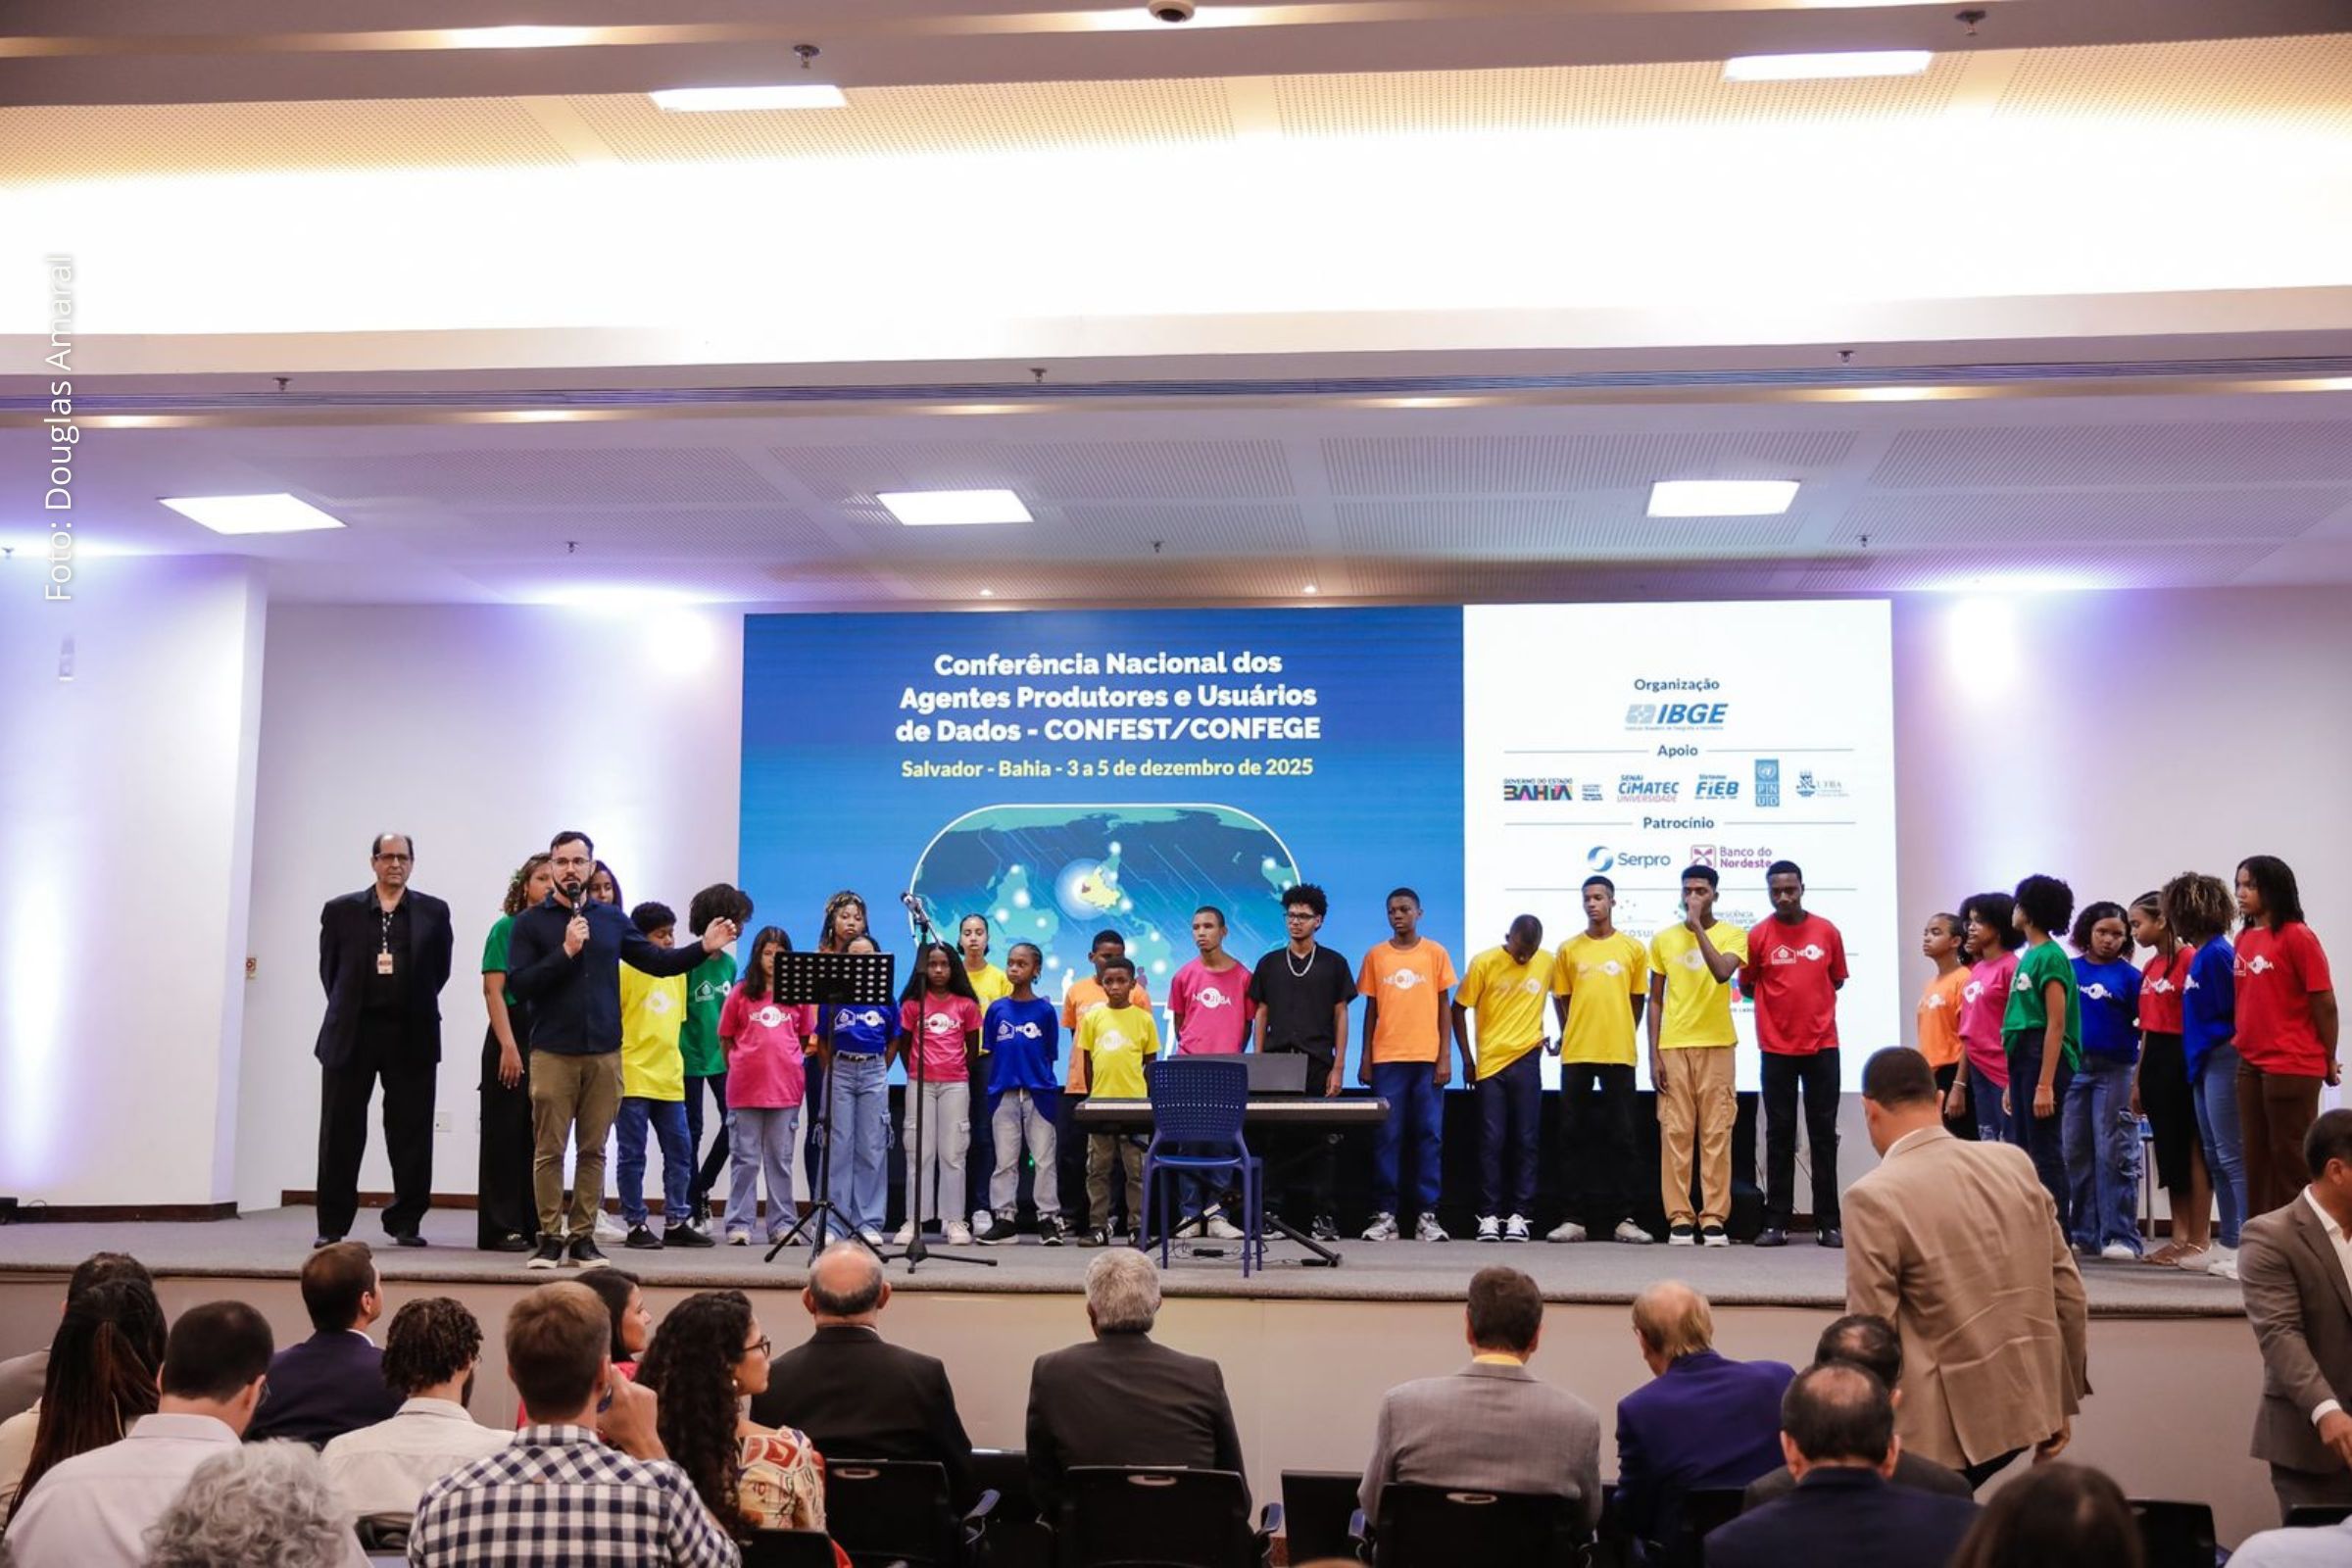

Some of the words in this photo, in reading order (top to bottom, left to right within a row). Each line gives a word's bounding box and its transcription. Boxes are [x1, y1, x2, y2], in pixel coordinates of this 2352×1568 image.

[934, 652, 1100, 676] Conferência
[1106, 651, 1227, 674] Nacional
[1232, 651, 1283, 673] dos
[1634, 678, 1720, 693] Organização
[900, 687, 1011, 714] Agentes
[1017, 685, 1168, 709] Produtores
[1174, 691, 1192, 707] e
[1198, 683, 1317, 708] Usuários
[1657, 703, 1729, 724] IBGE
[895, 720, 931, 742] de
[937, 719, 1021, 742] Dados
[1044, 716, 1321, 741] CONFEST/CONFEGE
[1657, 744, 1698, 759] Apoio
[902, 759, 983, 777] Salvador
[999, 759, 1051, 777] Bahia
[1067, 760, 1078, 776] 3
[1082, 764, 1094, 776] a
[1098, 760, 1108, 776] 5
[1112, 760, 1136, 776] de
[1140, 759, 1234, 776] dezembro
[1238, 759, 1261, 775] de
[1265, 759, 1313, 776] 2025
[1503, 785, 1573, 801] BAHIA
[1643, 816, 1714, 829] Patrocínio
[1720, 847, 1754, 857] Banco
[1757, 847, 1773, 857] do
[1618, 853, 1671, 868] Serpro
[1720, 858, 1772, 869] Nordeste
